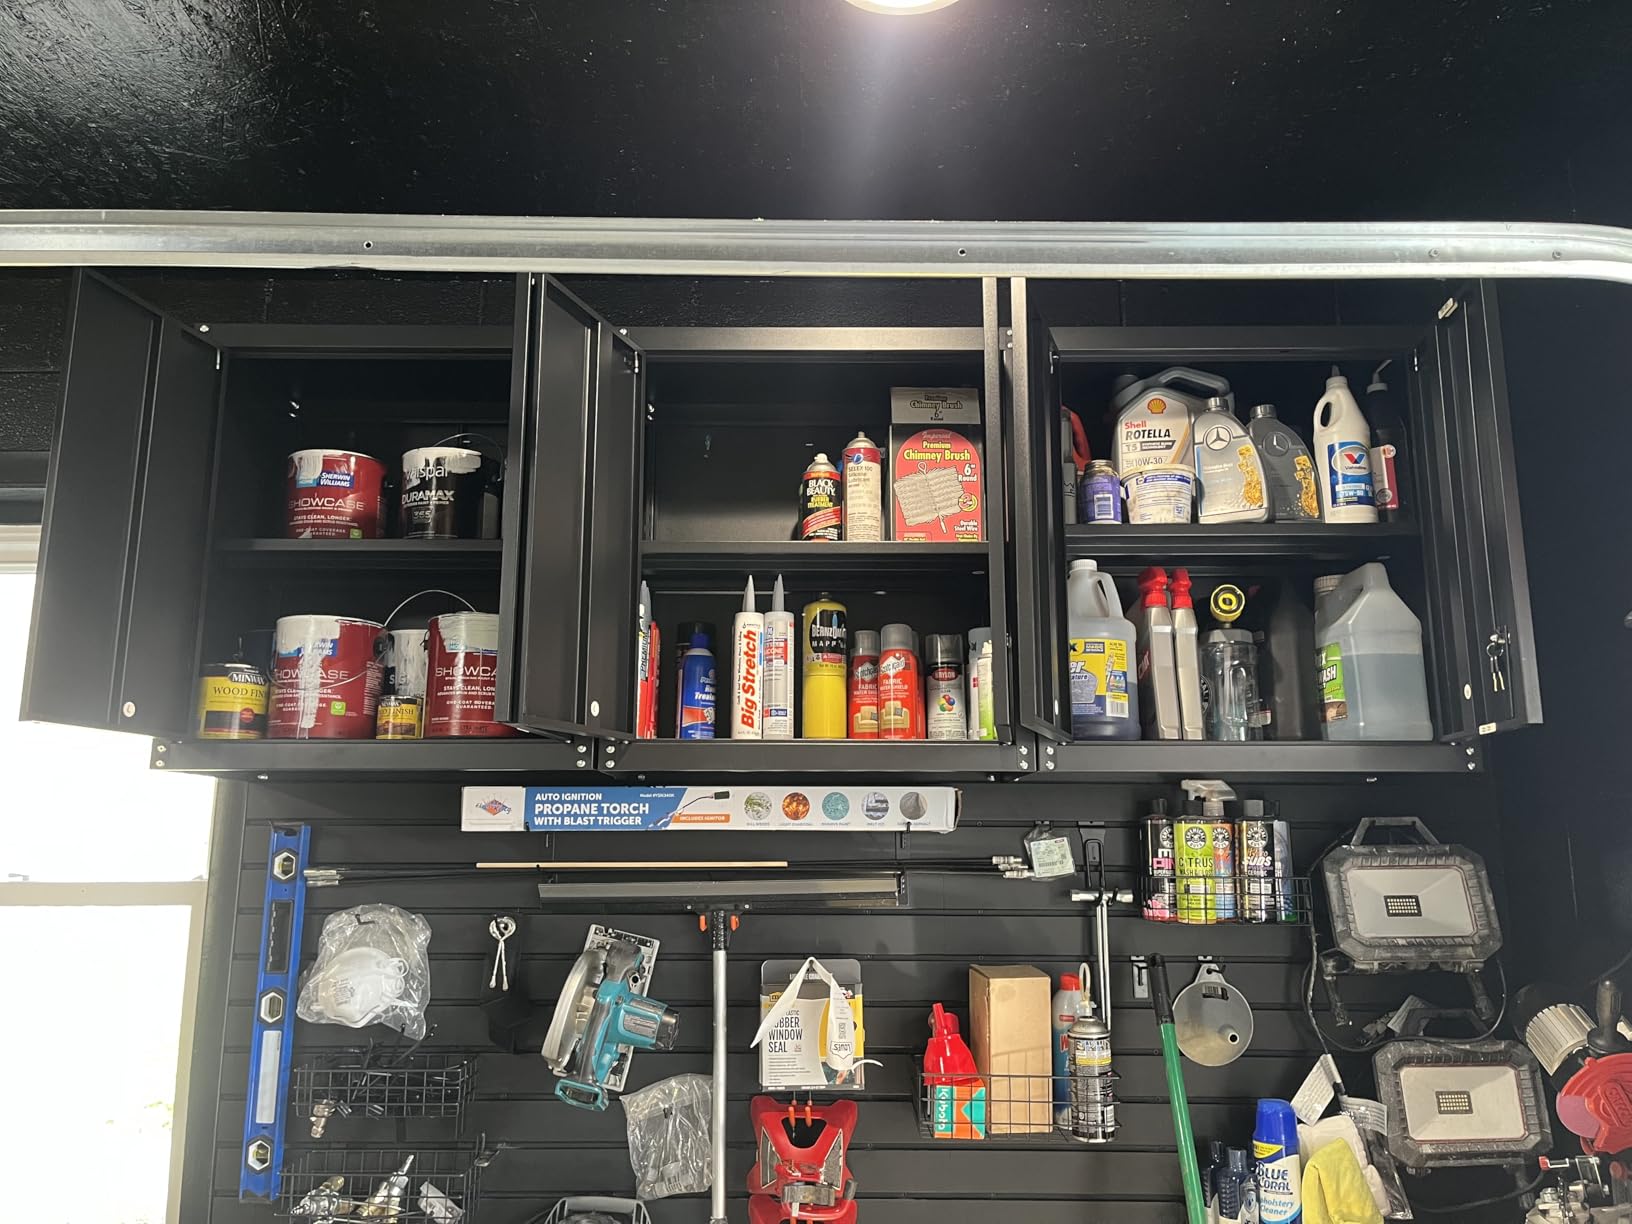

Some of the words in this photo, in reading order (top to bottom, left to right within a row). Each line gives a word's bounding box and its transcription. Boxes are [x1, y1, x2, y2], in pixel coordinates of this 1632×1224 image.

[909, 400, 940, 412] Chimney
[941, 401, 963, 409] Brush
[1124, 420, 1147, 430] Shell
[1125, 429, 1171, 441] ROTELLA
[922, 440, 951, 449] Premium
[903, 448, 942, 463] Chimney
[944, 449, 971, 461] Brush
[1135, 456, 1163, 467] 10W-30
[320, 478, 350, 487] WILLIAMS
[321, 472, 351, 481] SHERWIN
[958, 474, 977, 482] Round
[808, 479, 834, 488] BLACK
[401, 489, 455, 504] DURAMAX
[806, 487, 836, 496] BEAUTY
[289, 497, 365, 511] SHOWCASE
[742, 629, 757, 696] Stretch
[275, 668, 350, 681] HOWASE
[213, 686, 248, 696] WOOD
[250, 689, 265, 698] FIN
[741, 699, 757, 729] Big
[535, 793, 560, 801] AUTO
[562, 793, 602, 801] IGNITION
[534, 803, 599, 815] PROPANE
[601, 803, 649, 815] TORCH
[534, 816, 562, 825] WITH
[564, 816, 597, 825] BLAST
[598, 816, 642, 825] TRIGGER
[1242, 856, 1272, 867] SUDS
[768, 1029, 803, 1041] WINDOW
[768, 1041, 788, 1053] SEAL
[938, 1088, 949, 1130] Kubota
[1255, 1161, 1289, 1181] BLUE
[1258, 1177, 1291, 1191] CORAL
[1261, 1197, 1294, 1208] holstery
[1260, 1204, 1288, 1215] Cleaner
